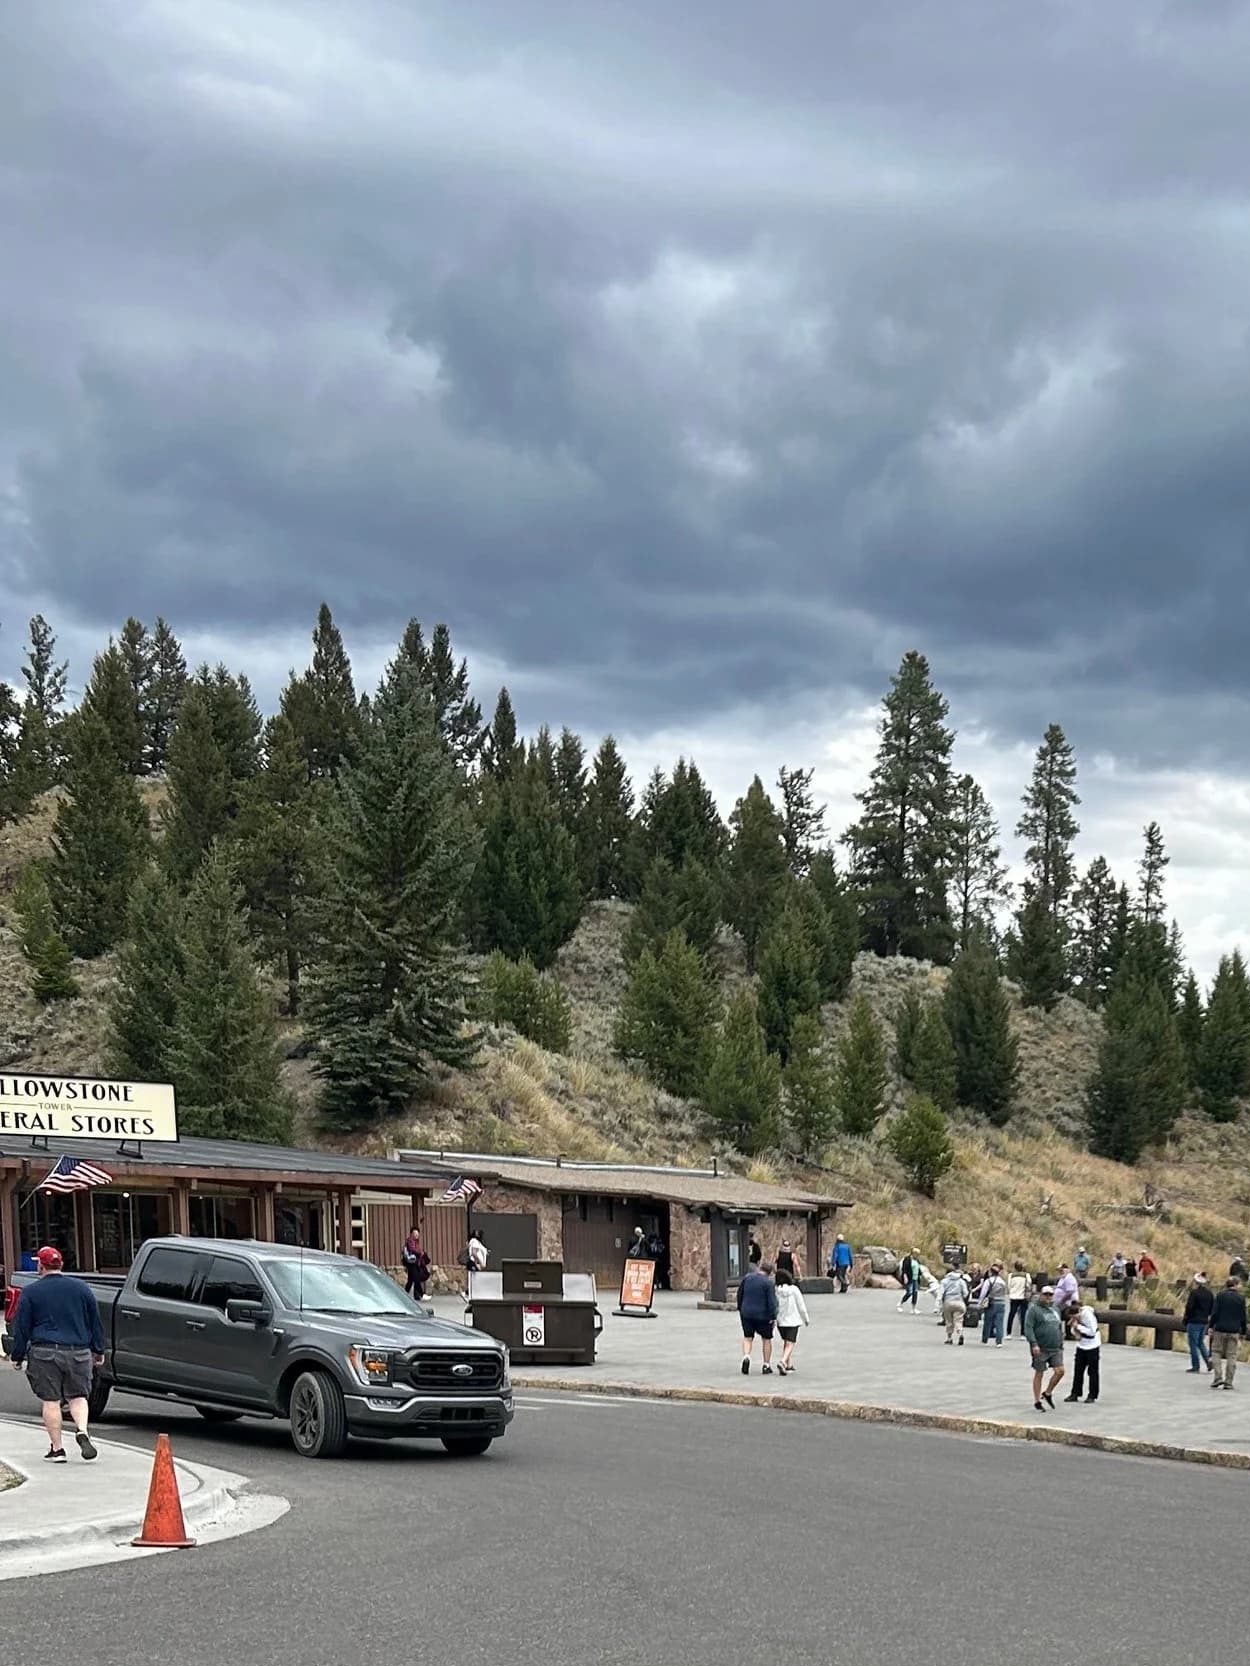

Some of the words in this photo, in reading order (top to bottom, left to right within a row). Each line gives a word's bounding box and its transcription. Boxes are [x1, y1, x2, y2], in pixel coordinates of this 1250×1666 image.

[0, 1078, 135, 1103] LLOWSTONE
[38, 1102, 73, 1111] TOWER
[0, 1111, 59, 1131] ERAL
[71, 1115, 155, 1136] STORES
